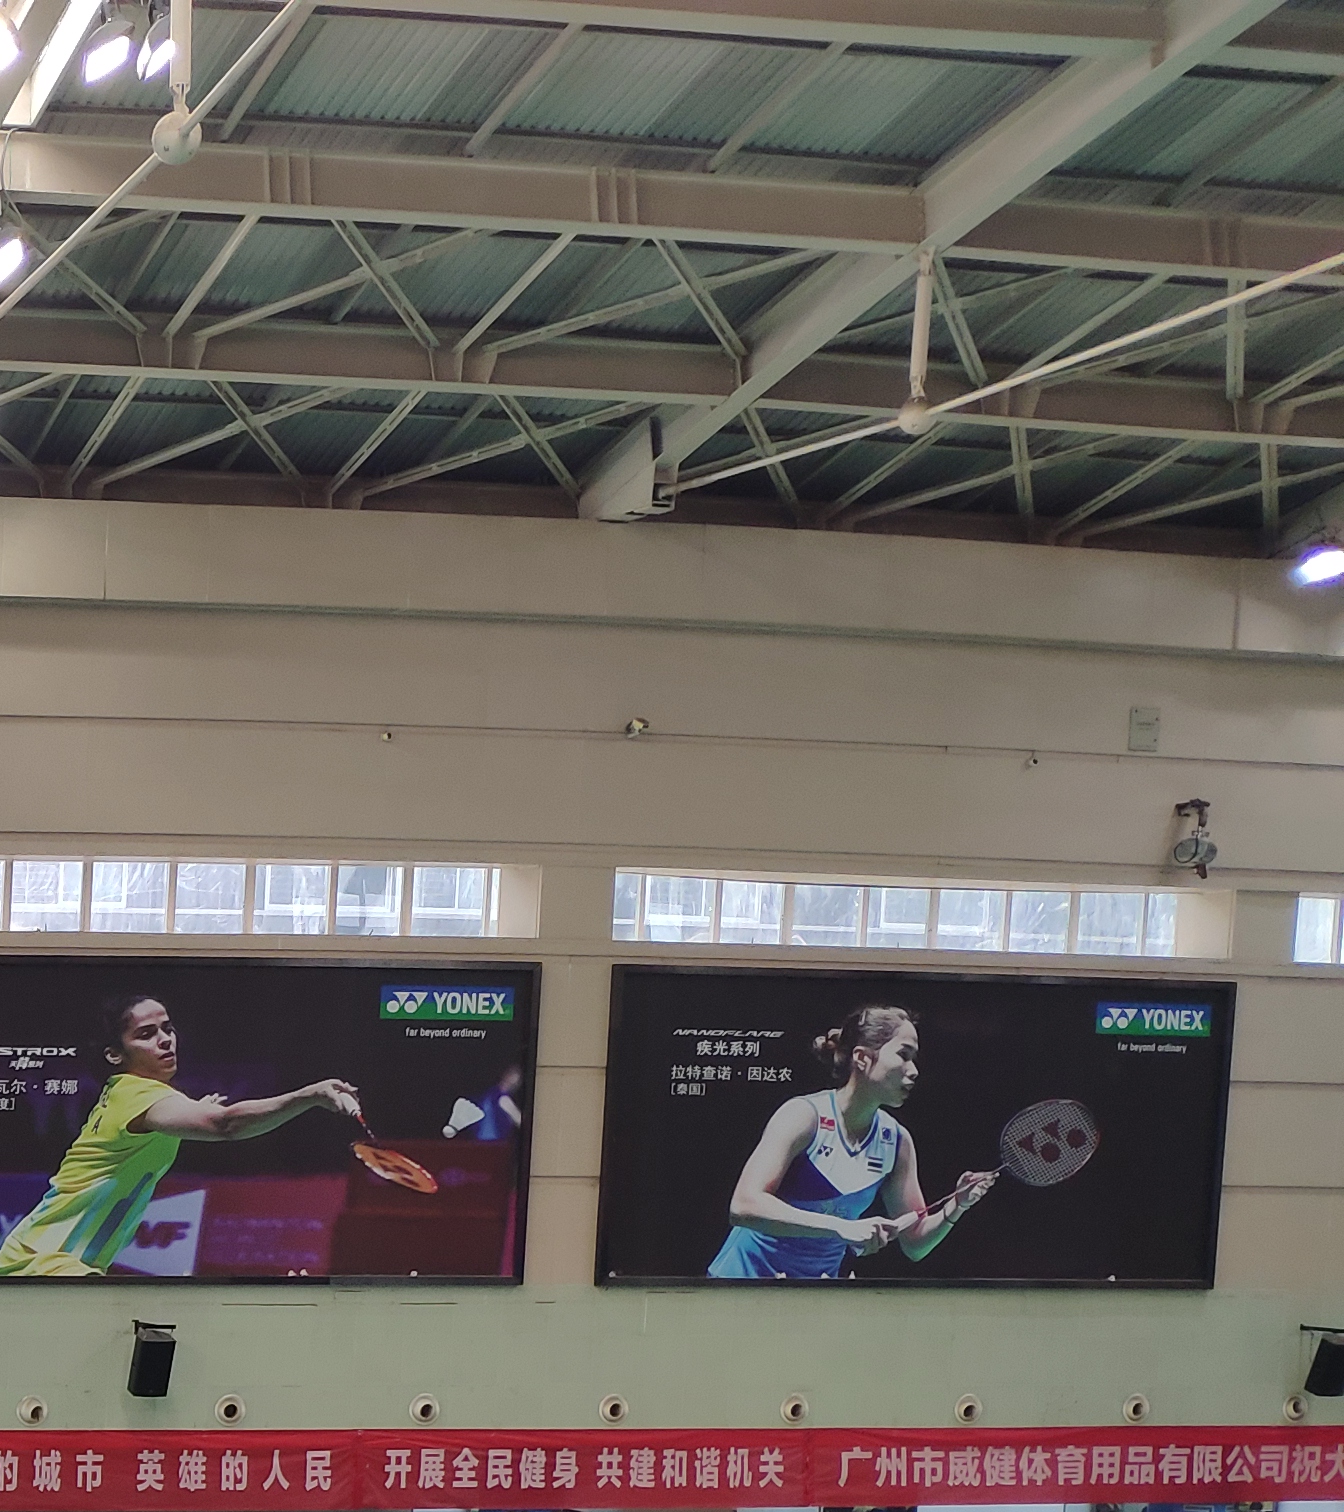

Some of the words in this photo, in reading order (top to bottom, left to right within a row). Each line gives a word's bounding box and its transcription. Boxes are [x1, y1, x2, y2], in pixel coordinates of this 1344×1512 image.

[432, 991, 505, 1016] YONEX
[1141, 1008, 1204, 1031] YONEX
[405, 1027, 417, 1037] far
[419, 1027, 450, 1039] beyond
[452, 1028, 487, 1040] ordinary
[673, 1029, 785, 1038] NANOFLARE
[696, 1040, 760, 1057] 疾光系列
[671, 1064, 793, 1082] 拉特查诺·因达农
[137, 1449, 332, 1492] 英雄的人民
[384, 1448, 580, 1490] 开展全民健身
[595, 1446, 785, 1490] 共建和谐机关
